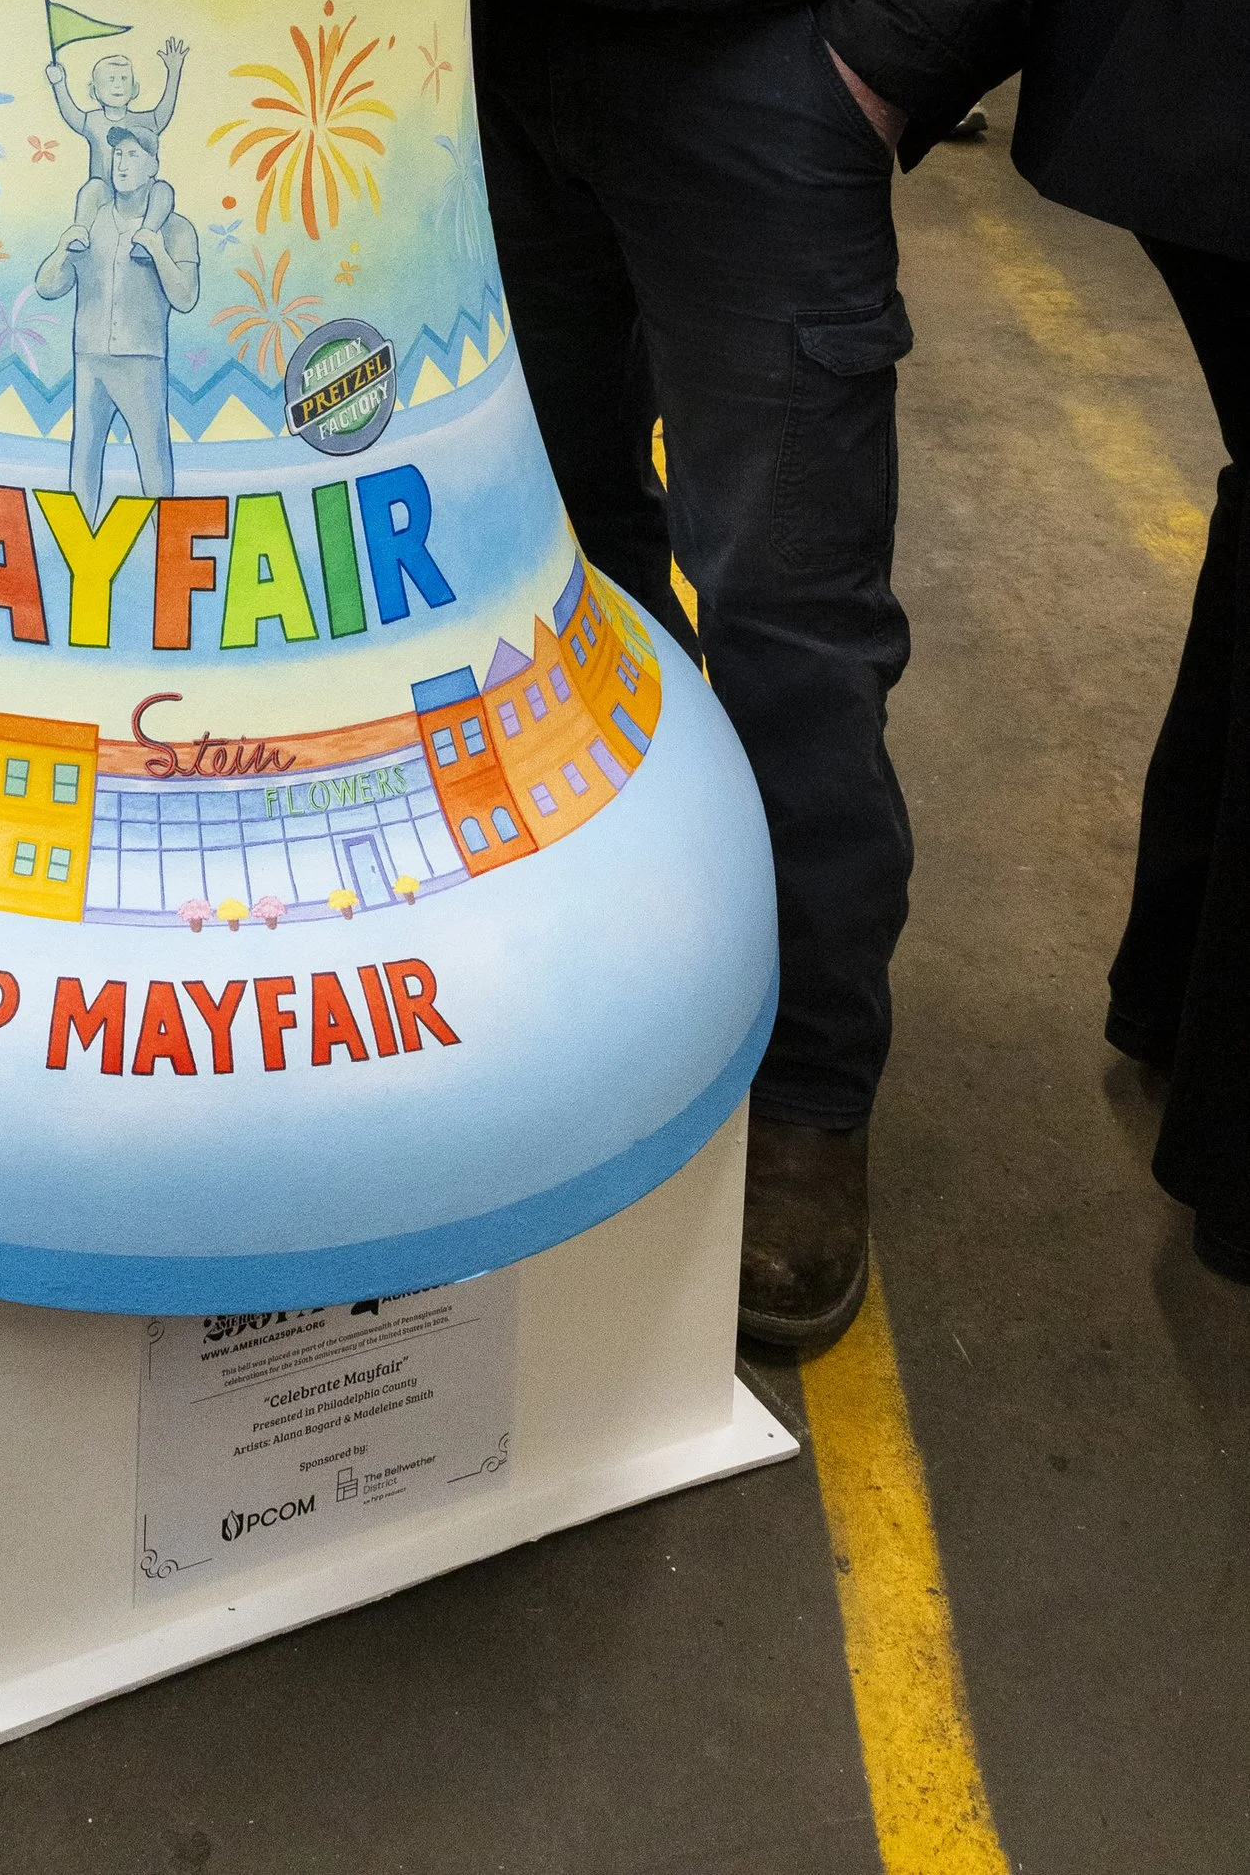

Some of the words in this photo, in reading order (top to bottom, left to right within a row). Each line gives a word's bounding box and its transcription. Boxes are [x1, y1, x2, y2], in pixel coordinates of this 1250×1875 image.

[301, 354, 388, 423] PRETZEL
[302, 336, 363, 388] PHILLY
[318, 380, 389, 441] FACTORY
[131, 692, 297, 777] Stein
[264, 764, 408, 818] FLOWERS
[46, 958, 462, 1076] MAYFAIR
[201, 1320, 326, 1361] WWW.AMERICA250PA.ORG
[221, 1368, 237, 1377] This
[237, 1363, 251, 1373] bell
[252, 1359, 266, 1368] was
[267, 1351, 291, 1365] placed
[292, 1349, 300, 1357] as
[301, 1344, 317, 1357] part
[317, 1338, 326, 1349] of
[326, 1338, 337, 1347] the
[338, 1322, 392, 1343] Commonwealth
[392, 1318, 400, 1327] of
[400, 1304, 452, 1325] Pennsylvania's
[224, 1369, 268, 1387] celebrations
[268, 1364, 280, 1375] for
[281, 1362, 293, 1371] the
[293, 1356, 313, 1368] 250th
[314, 1342, 357, 1361] anniversary
[358, 1337, 366, 1348] of
[366, 1334, 378, 1345] the
[378, 1328, 402, 1341] United
[402, 1324, 424, 1336] States
[424, 1320, 431, 1329] in
[432, 1316, 450, 1327] 2026.
[233, 1437, 271, 1457] Artists:
[272, 1427, 303, 1445] Alana
[305, 1415, 342, 1435] Bogard
[343, 1413, 352, 1424] &
[353, 1398, 403, 1422] Madeleine
[405, 1388, 435, 1405] Smith
[252, 1410, 303, 1433] Presented
[305, 1405, 315, 1417] in
[317, 1389, 380, 1415] Philadelphia
[382, 1377, 418, 1395] County
[299, 1447, 351, 1472] Sponsored
[353, 1444, 369, 1456] by:
[363, 1477, 399, 1495] District
[364, 1472, 382, 1484] The
[384, 1455, 437, 1478] Bellwether
[247, 1494, 315, 1533] PCOM
